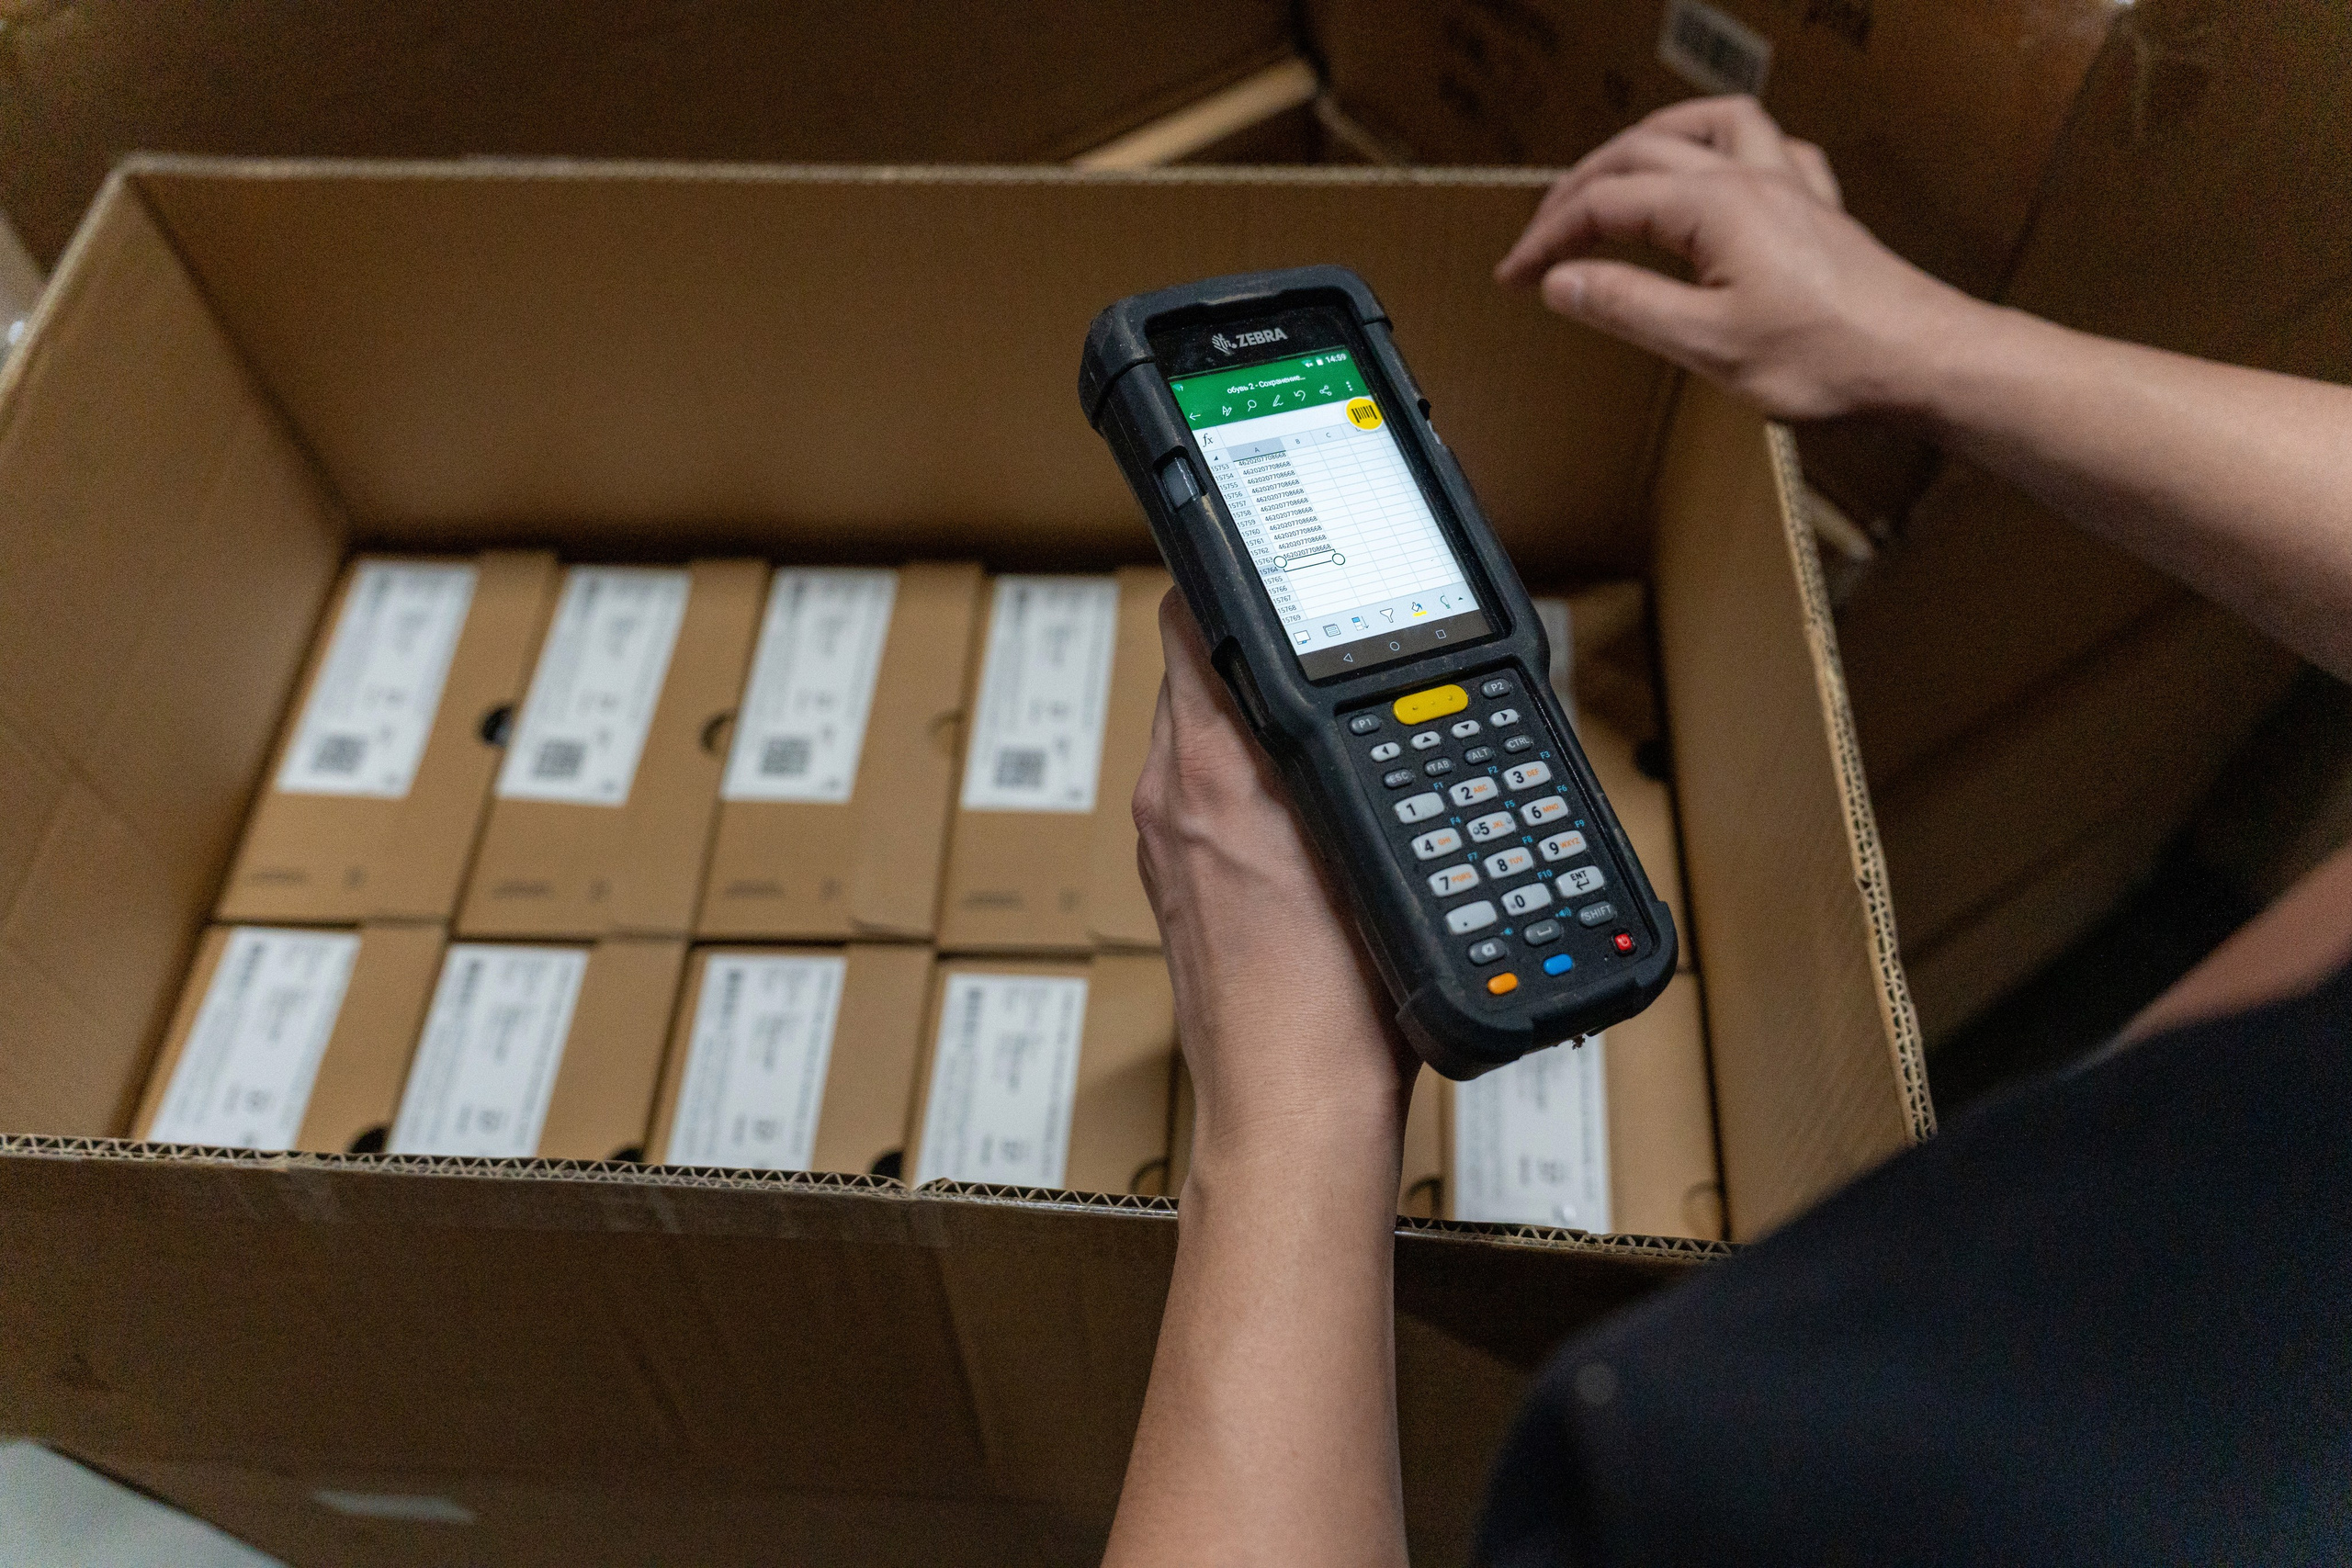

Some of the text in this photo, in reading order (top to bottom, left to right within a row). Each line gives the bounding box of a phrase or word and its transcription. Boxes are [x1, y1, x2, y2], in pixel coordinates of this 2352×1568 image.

[1236, 327, 1288, 348] ZEBRA
[1325, 353, 1347, 364] 14:59
[1227, 383, 1249, 395] обувь
[1491, 682, 1504, 692] P2
[1358, 718, 1372, 728] P1
[1508, 737, 1530, 749] CTRL
[1472, 749, 1488, 760] ALT
[1540, 751, 1551, 760] F3
[1431, 761, 1449, 771] TAB
[1488, 766, 1498, 774] F2
[1390, 772, 1408, 784] ESC
[1513, 771, 1524, 784] 3
[1433, 782, 1444, 791] F1
[1557, 785, 1568, 793] F6
[1461, 787, 1473, 800] 2
[1406, 803, 1416, 816] 1
[1505, 800, 1515, 809] F5
[1531, 806, 1542, 819] 6
[1450, 816, 1461, 825] F4
[1574, 820, 1585, 828] F9
[1479, 822, 1490, 835] 5
[1522, 836, 1533, 844] F8
[1425, 840, 1434, 853] 4
[1549, 842, 1559, 854] 9
[1467, 852, 1478, 861] F7
[1497, 859, 1508, 871] 8
[1537, 870, 1553, 880] F10
[1570, 870, 1587, 881] ENT
[1439, 876, 1449, 890] 7
[1515, 895, 1525, 908] 0
[1583, 905, 1611, 921] SHIFT
